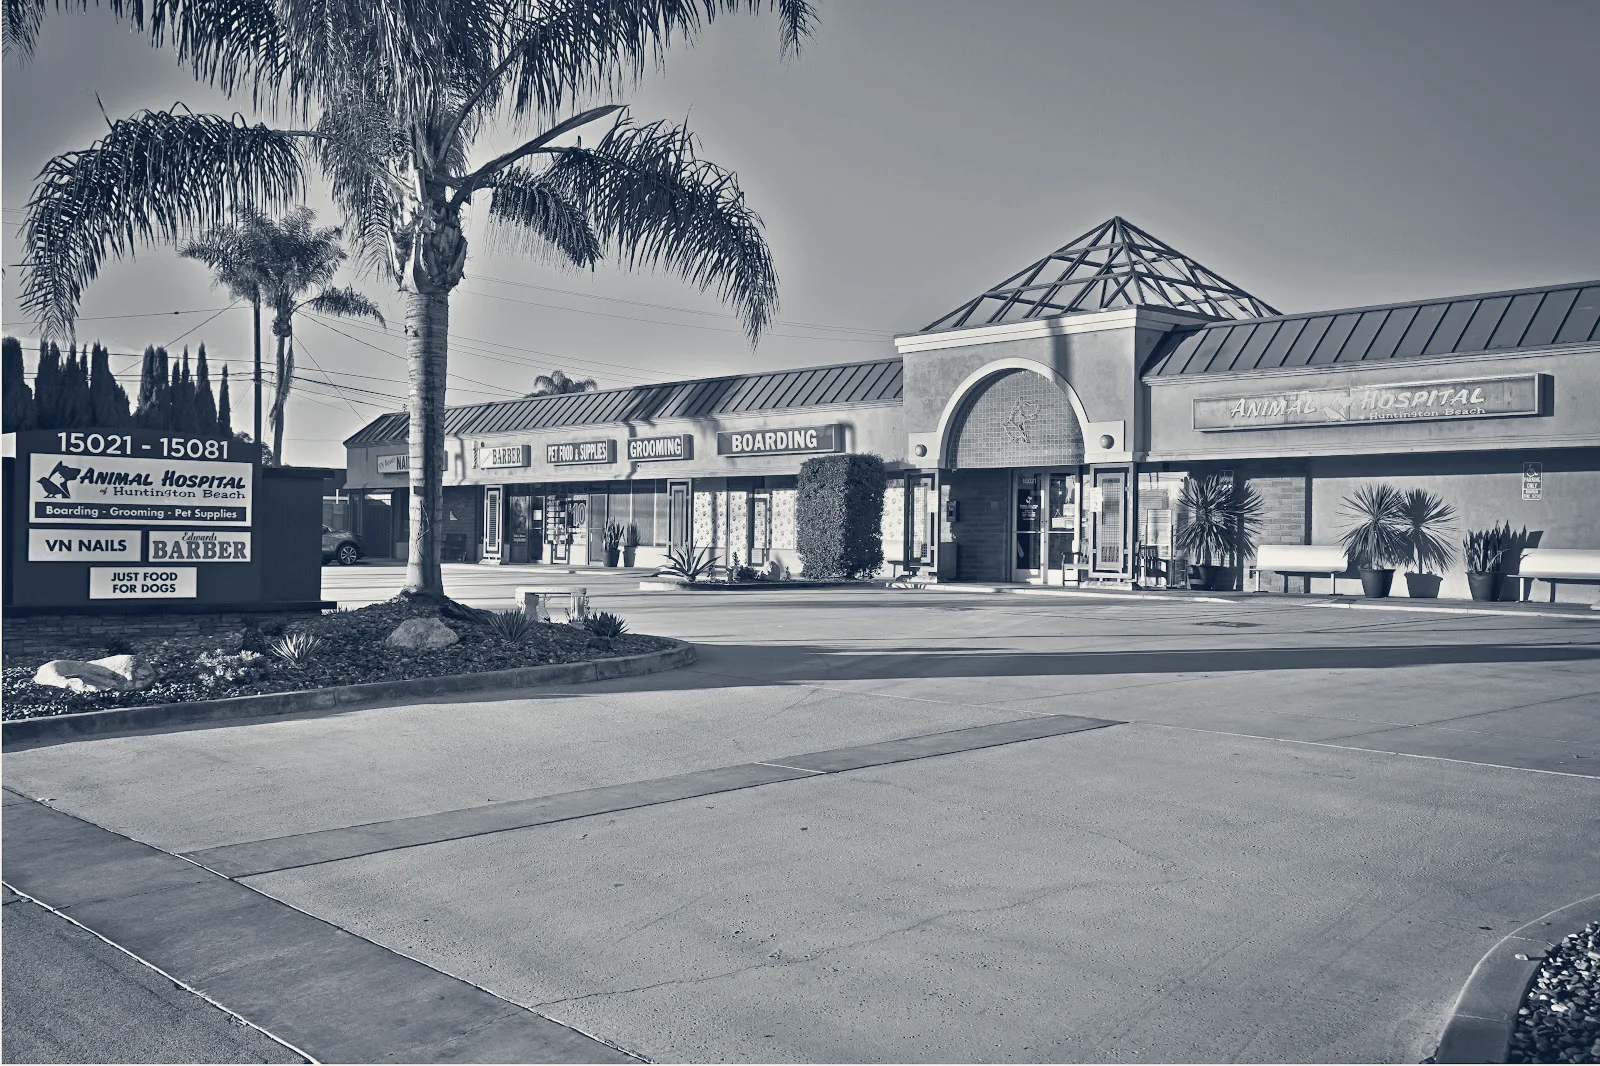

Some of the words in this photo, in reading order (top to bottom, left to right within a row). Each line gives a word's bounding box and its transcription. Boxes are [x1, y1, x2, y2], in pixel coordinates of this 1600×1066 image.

[1231, 398, 1317, 418] ANIMAL
[1361, 387, 1485, 410] HOSPITAL
[1370, 411, 1439, 420] Huntington
[1445, 407, 1486, 416] Beach
[58, 432, 131, 454] 15021
[160, 438, 228, 459] 15081
[630, 438, 682, 458] GROOMING
[731, 429, 818, 453] BOARDING
[492, 447, 521, 465] BARBER
[548, 446, 558, 462] PET
[560, 445, 573, 461] FOOD
[580, 443, 607, 460] SUPPLIES
[80, 467, 153, 485] ANIMAL
[161, 470, 246, 489] HOSPITAL
[113, 487, 196, 498] Huntington
[203, 490, 246, 499] Beach
[46, 506, 99, 518] Boarding
[110, 508, 164, 519] Grooming
[175, 509, 192, 518] Pet
[194, 510, 237, 520] Supplies
[45, 540, 71, 551] VN
[78, 540, 127, 551] NAILS
[182, 532, 217, 542] Edwards
[152, 541, 248, 560] BARBER
[111, 572, 140, 582] JUST
[143, 572, 178, 582] FOOD
[112, 584, 137, 593] FOR
[141, 584, 176, 593] DOGS
